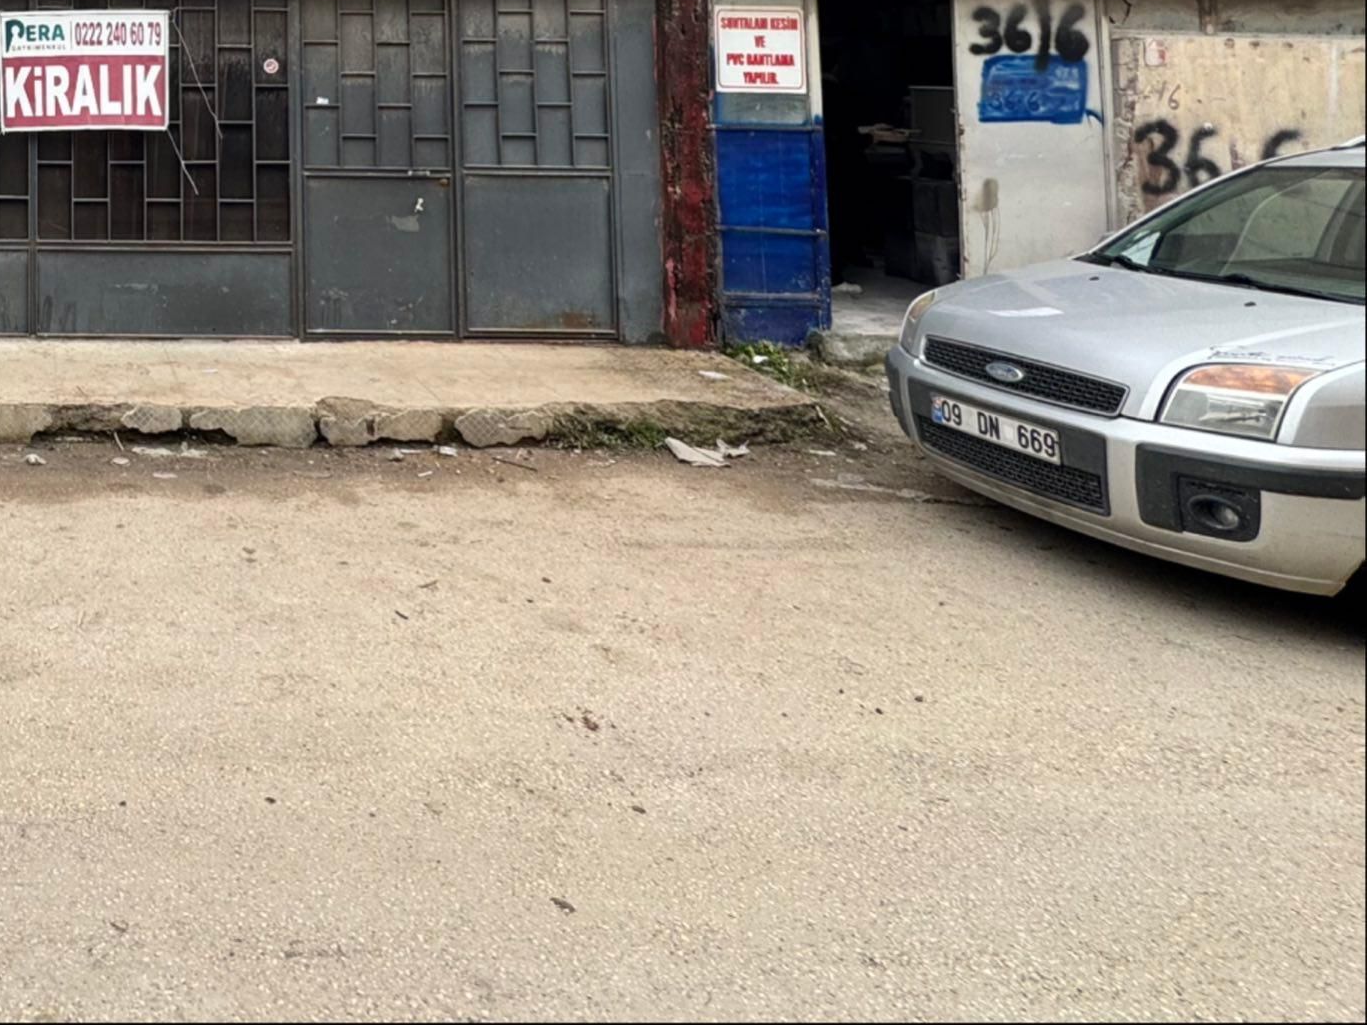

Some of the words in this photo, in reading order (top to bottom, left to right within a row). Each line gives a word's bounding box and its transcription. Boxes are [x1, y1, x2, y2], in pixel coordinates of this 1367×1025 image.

[5, 19, 65, 53] PERA
[74, 22, 103, 46] 0222
[106, 22, 128, 45] 240
[130, 22, 144, 45] 60
[147, 22, 162, 45] 79
[754, 35, 766, 48] VE
[726, 53, 745, 66] PVC
[941, 400, 962, 426] 09
[976, 411, 1001, 440] DN
[1017, 424, 1057, 457] 669
